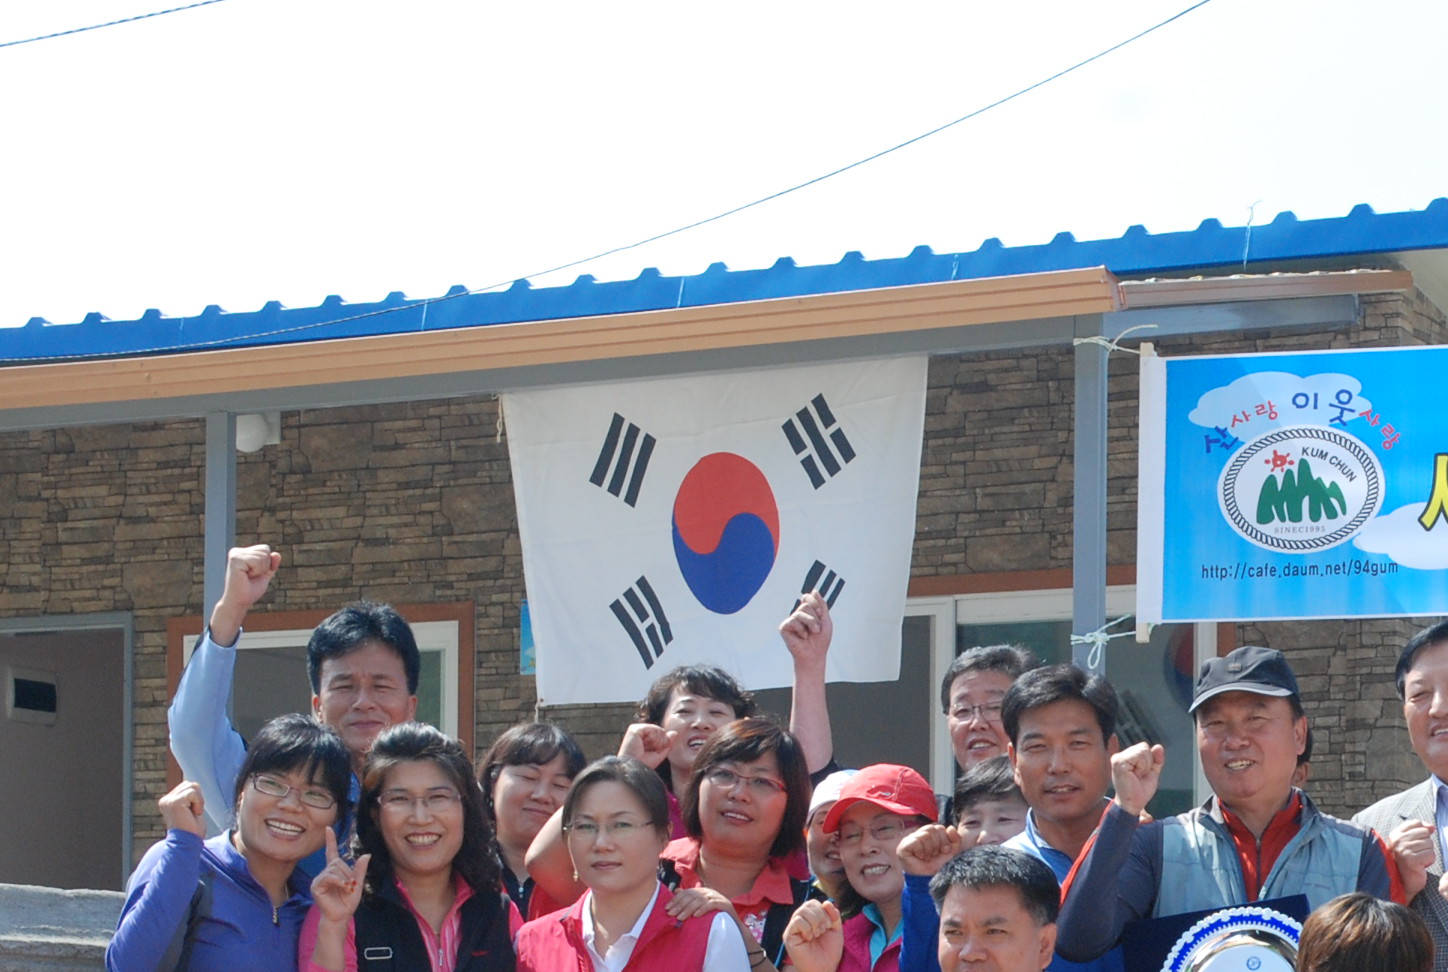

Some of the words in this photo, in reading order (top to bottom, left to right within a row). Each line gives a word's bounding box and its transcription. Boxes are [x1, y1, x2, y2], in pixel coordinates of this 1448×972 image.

[1205, 400, 1279, 453] 산사랑
[1291, 389, 1401, 450] 이웃사랑
[1301, 446, 1329, 461] KUM
[1329, 456, 1358, 482] CHUN
[1201, 560, 1399, 581] http://cafe.daum.net/94gum
